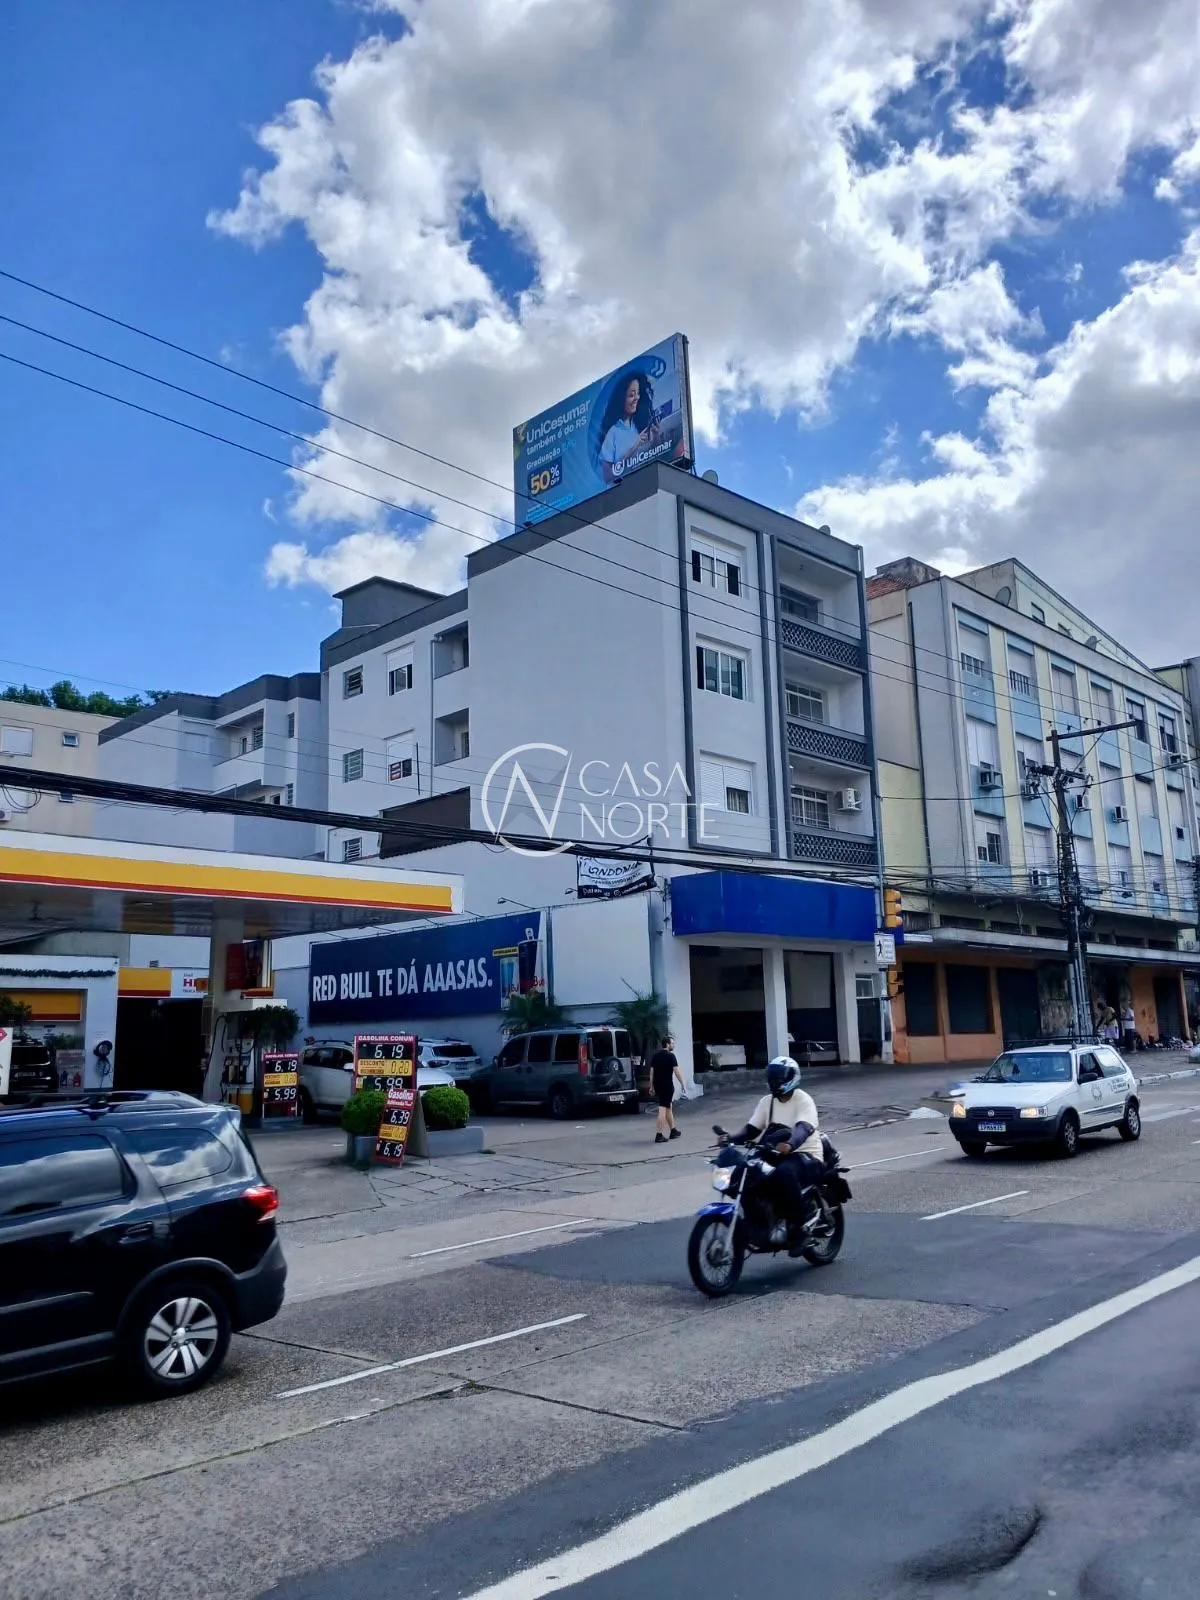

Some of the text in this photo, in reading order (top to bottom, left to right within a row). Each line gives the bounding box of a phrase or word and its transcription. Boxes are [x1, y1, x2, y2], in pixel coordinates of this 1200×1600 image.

[526, 400, 590, 443] UniCesumar
[526, 433, 557, 456] também
[564, 423, 575, 436] do
[575, 415, 588, 429] RS
[526, 447, 561, 470] Graduação
[626, 439, 673, 468] UniCesumar
[312, 974, 338, 1002] RED
[340, 970, 373, 1000] BULL
[376, 968, 394, 997] TE
[397, 957, 420, 996] DÁ
[422, 956, 494, 993] AAASAS.
[388, 1089, 414, 1100] Gasolina
